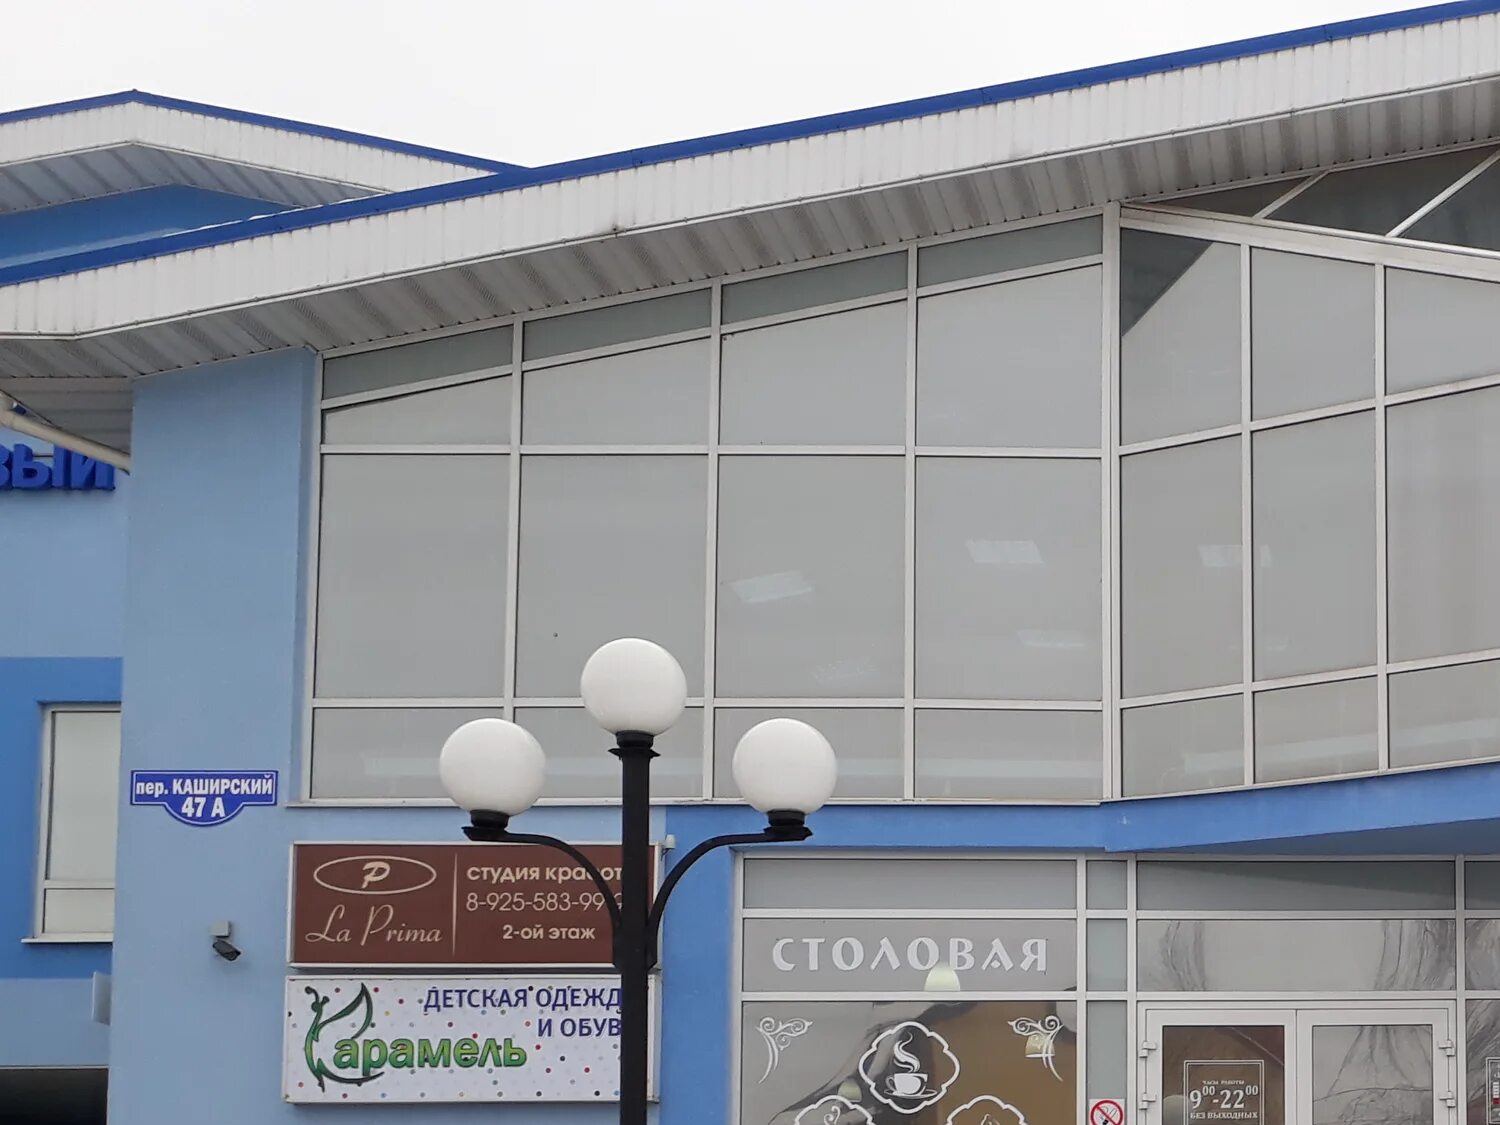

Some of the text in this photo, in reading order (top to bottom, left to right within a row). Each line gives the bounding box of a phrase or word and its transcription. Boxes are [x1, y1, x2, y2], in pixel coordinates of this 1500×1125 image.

[136, 774, 272, 798] пер. КАШИРСКИЙ
[181, 796, 206, 817] 47
[466, 865, 622, 886] студия краот
[305, 904, 443, 946] La Prima
[502, 923, 596, 940] 2-ой этаж
[772, 936, 1048, 971] СТОЛОВАЯ
[424, 986, 622, 1012] ДЕТСКАЯ ОДЕЖД
[537, 1018, 622, 1037] И ОБУВ
